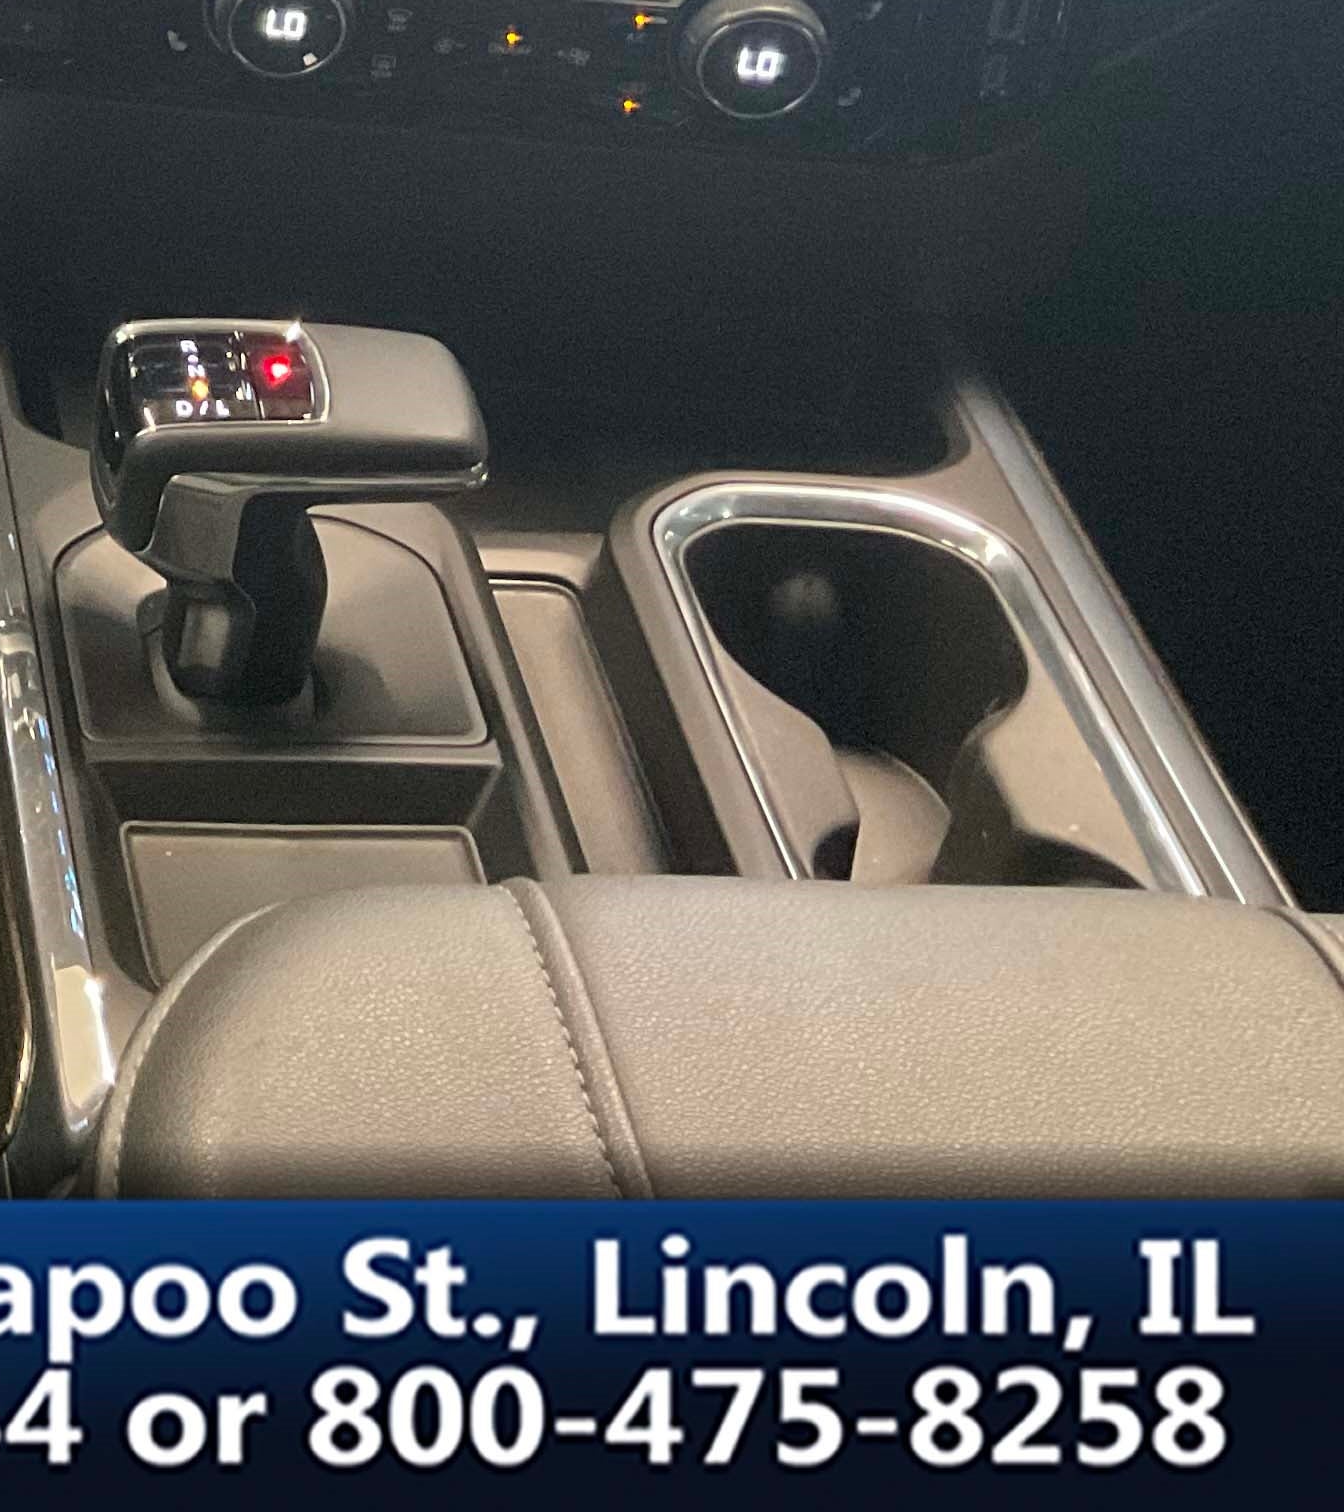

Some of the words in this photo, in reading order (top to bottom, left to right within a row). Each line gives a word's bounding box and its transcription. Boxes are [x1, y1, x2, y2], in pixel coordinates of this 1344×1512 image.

[263, 8, 307, 41] LO
[737, 47, 786, 82] LO
[188, 364, 205, 378] N
